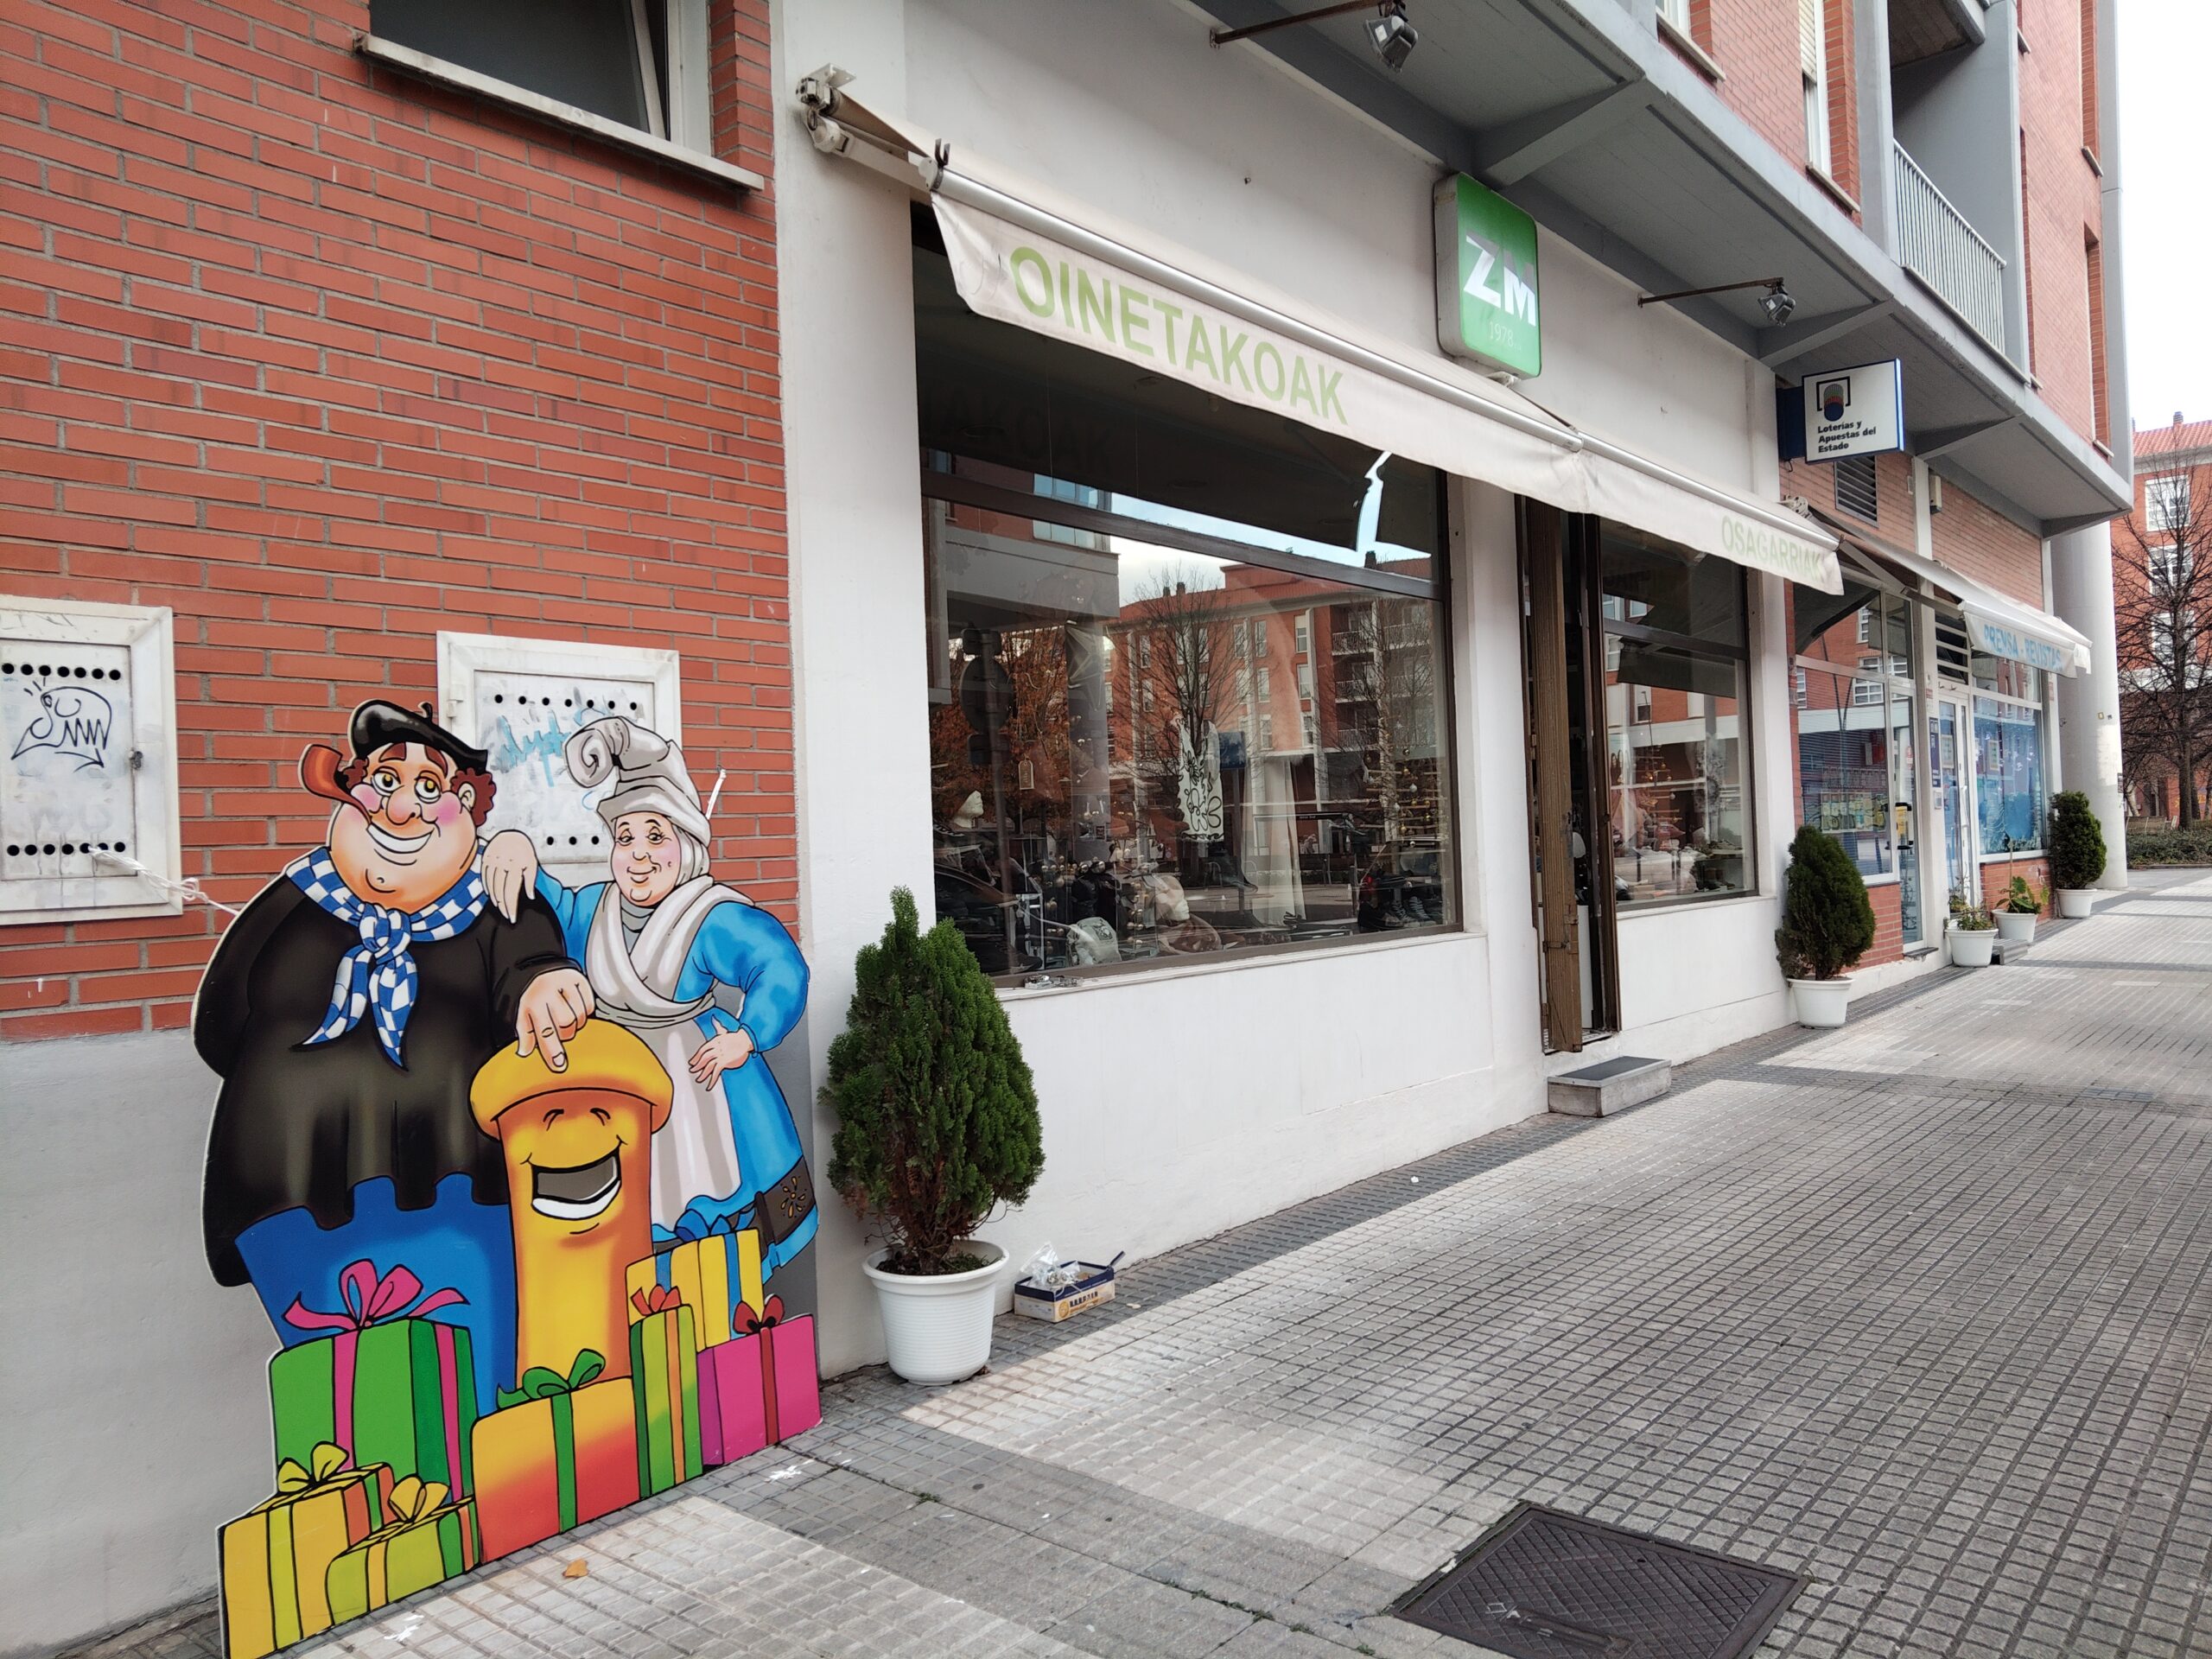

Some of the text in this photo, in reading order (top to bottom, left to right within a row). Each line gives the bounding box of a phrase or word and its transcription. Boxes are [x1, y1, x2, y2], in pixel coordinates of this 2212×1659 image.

[1463, 230, 1536, 327] ZM
[1009, 246, 1347, 424] OINETAKOAK
[1818, 426, 1876, 443] Apuestas del
[1818, 442, 1849, 453] Estado
[1857, 421, 1862, 429] y
[1721, 515, 1824, 582] OSAGARRIAK
[1984, 624, 2019, 658] PRENSA
[2024, 638, 2063, 671] REVISTAS
